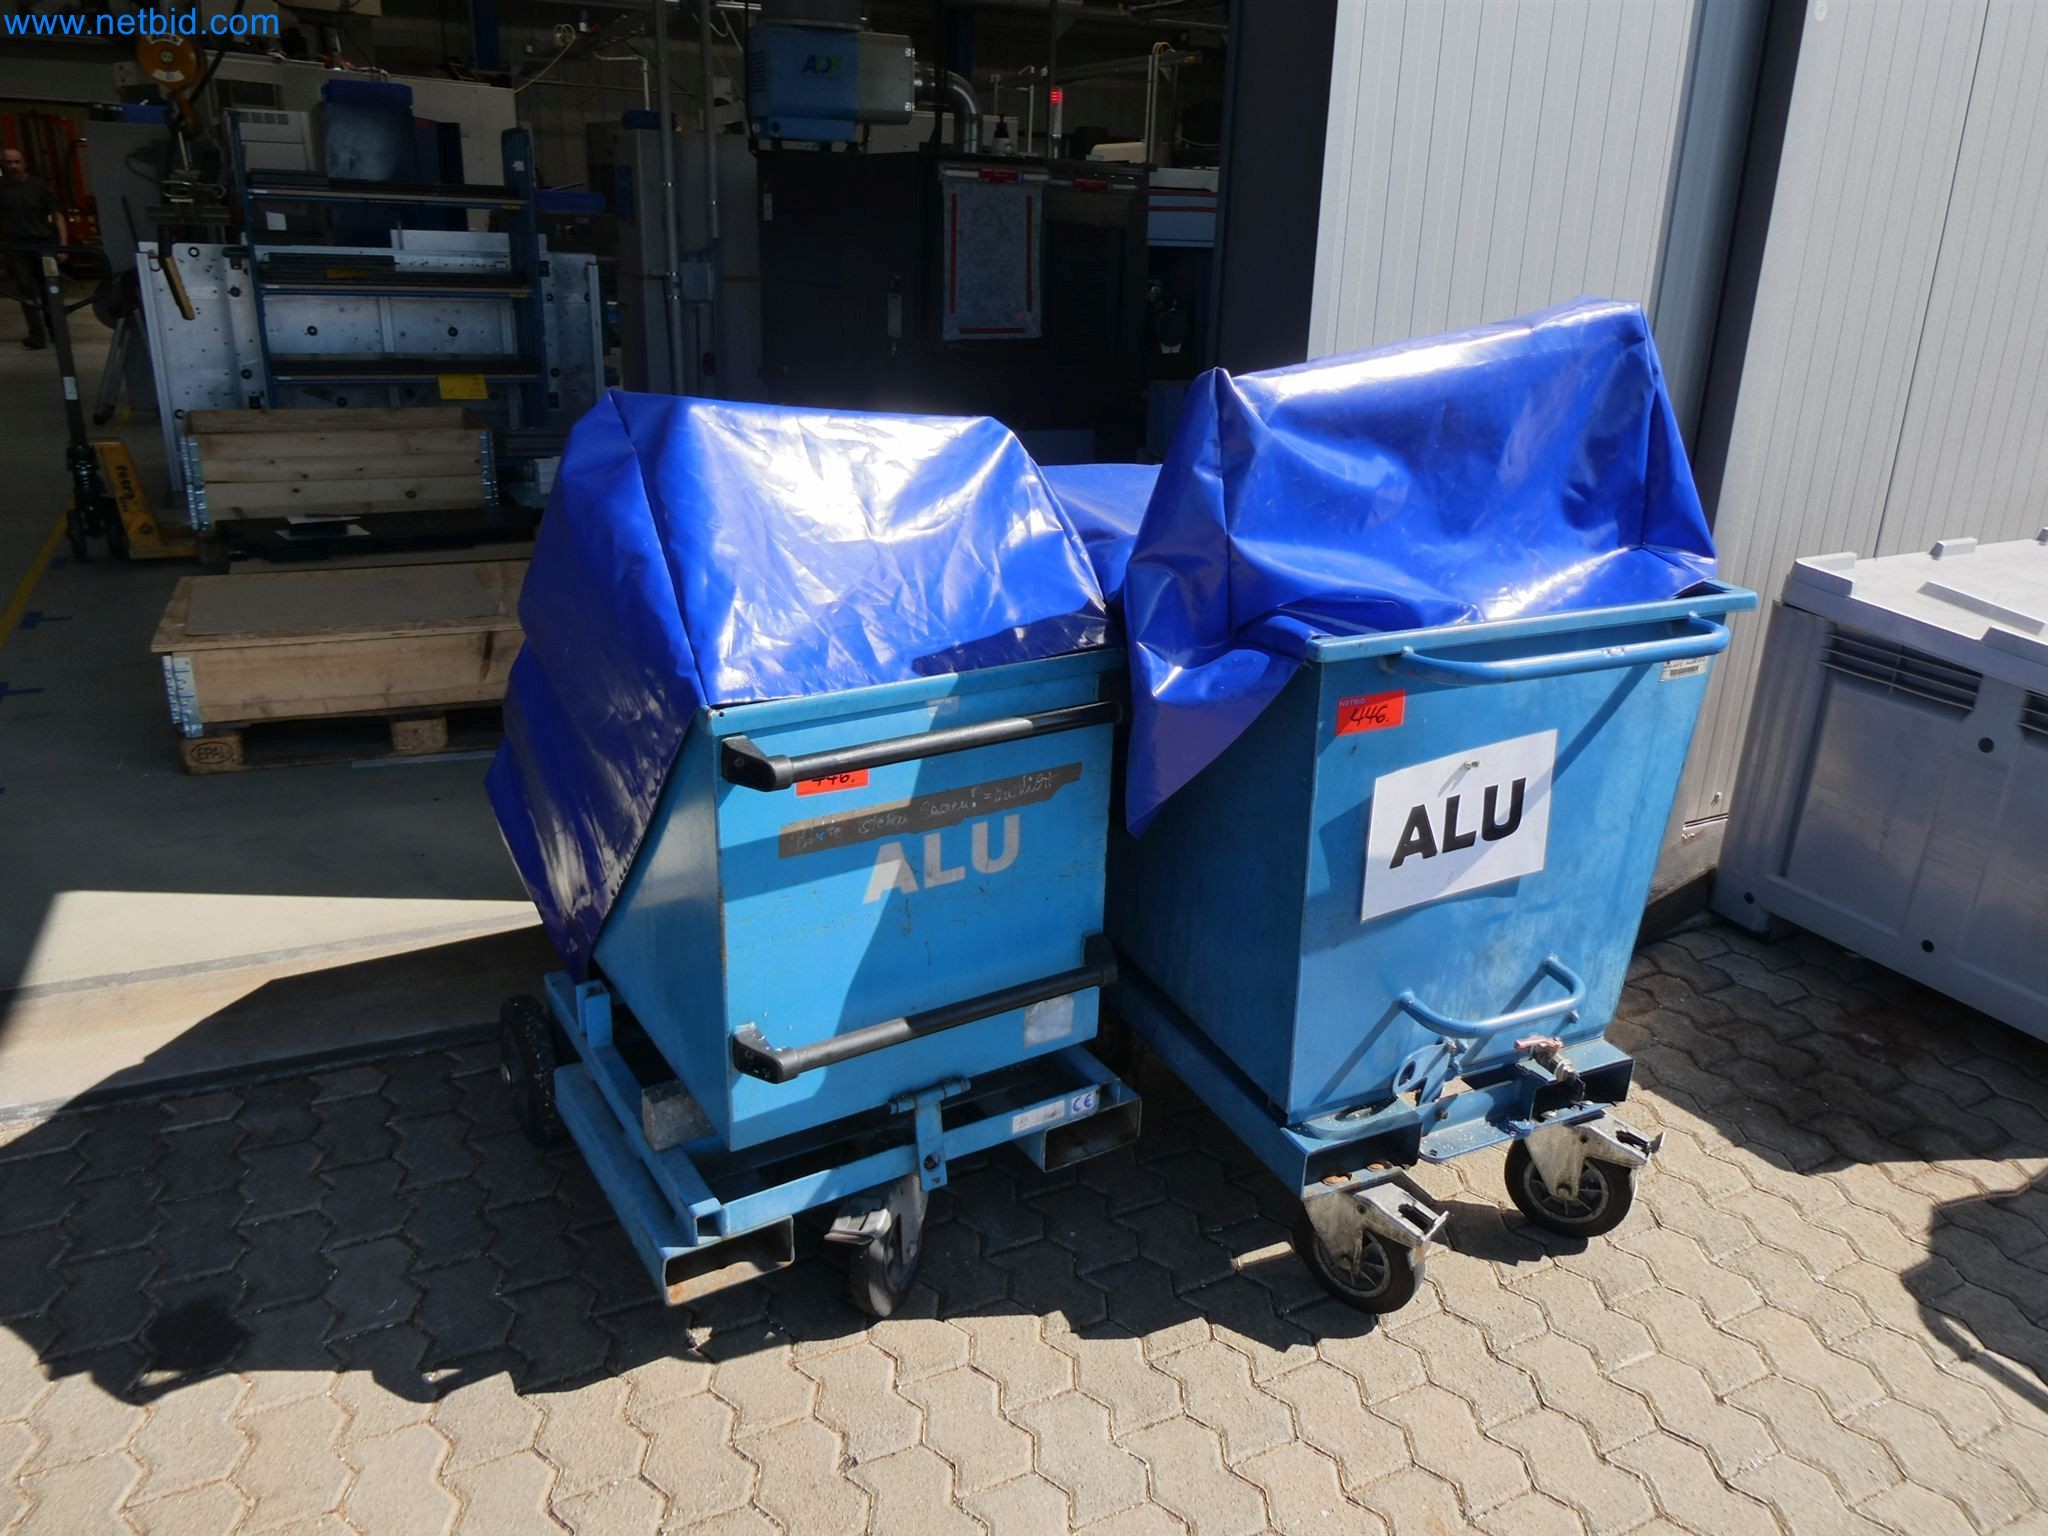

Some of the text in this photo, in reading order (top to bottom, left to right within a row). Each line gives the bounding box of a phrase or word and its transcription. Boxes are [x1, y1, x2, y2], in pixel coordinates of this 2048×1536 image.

[197, 746, 227, 760] EPAL
[862, 814, 1020, 904] ALU
[1389, 777, 1527, 869] ALU
